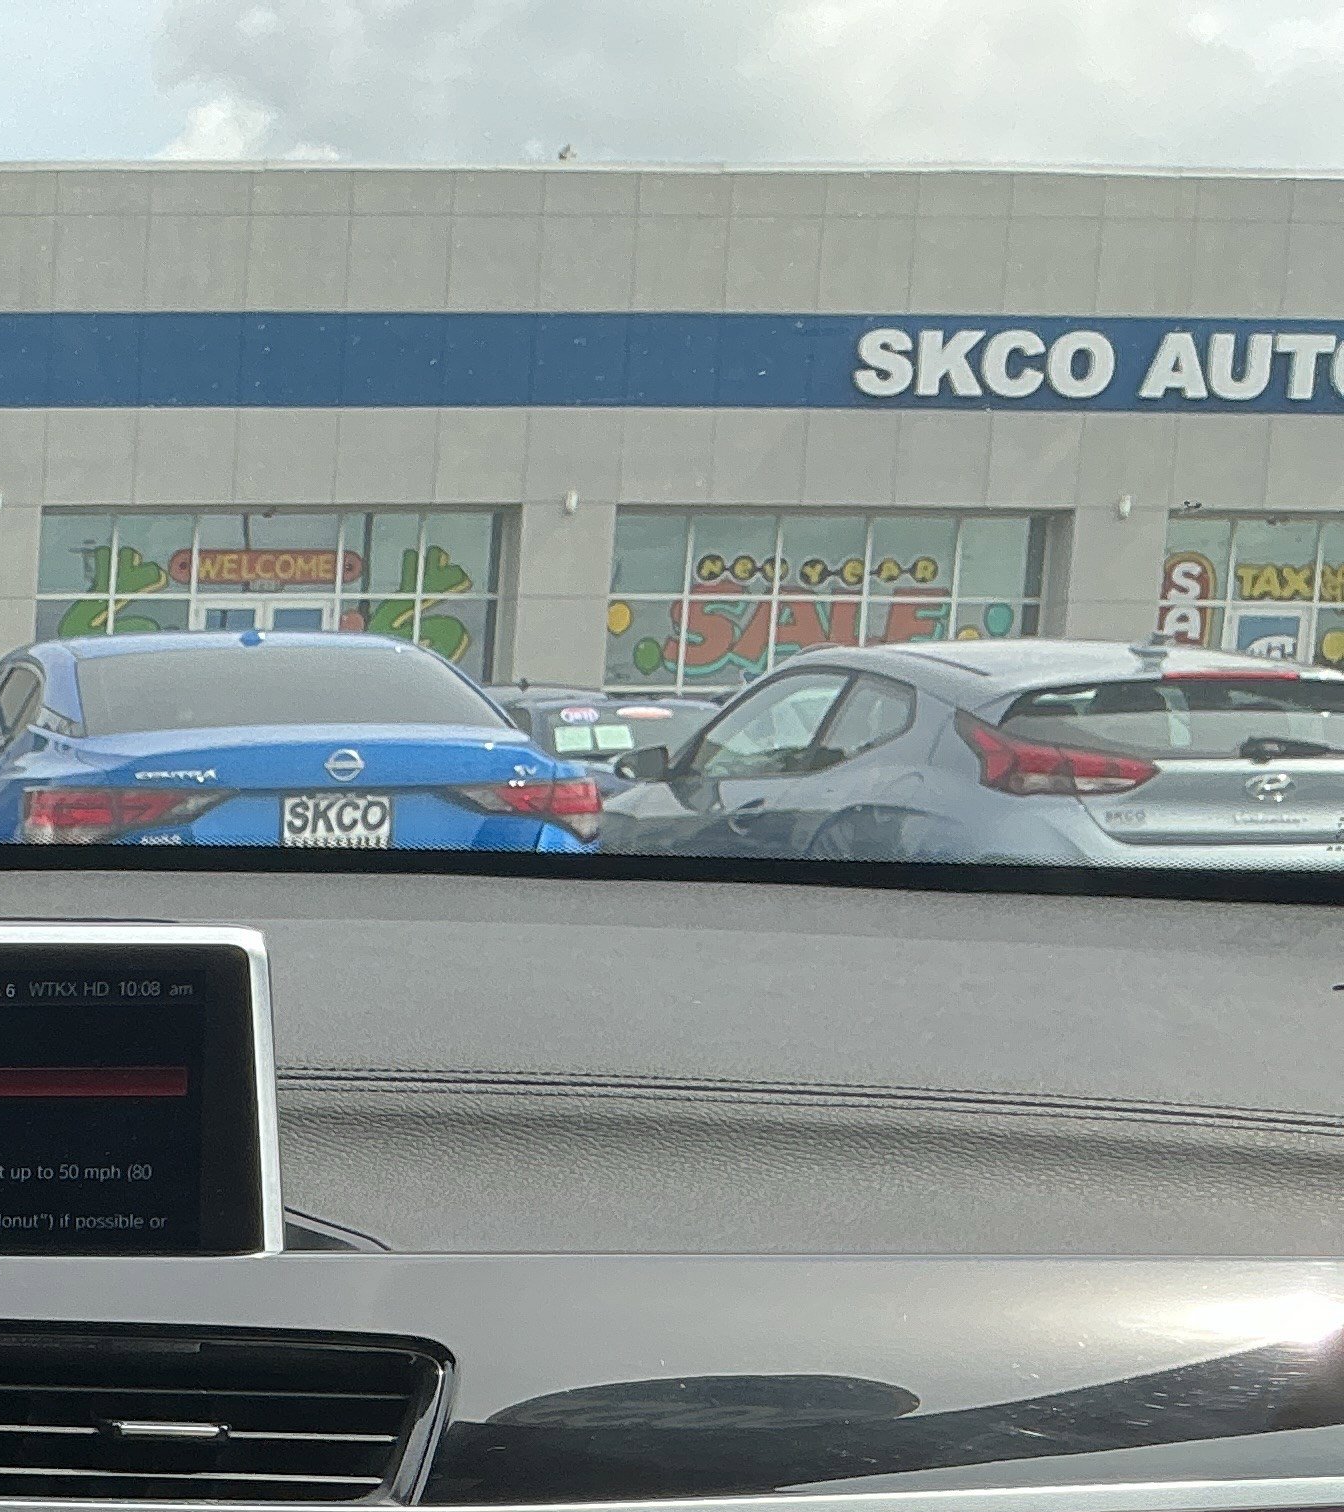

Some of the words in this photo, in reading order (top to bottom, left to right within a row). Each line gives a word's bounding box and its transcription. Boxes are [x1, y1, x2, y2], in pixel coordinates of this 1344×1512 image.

[852, 328, 1115, 399] SKCO
[1138, 331, 1344, 400] AUT
[198, 554, 336, 580] WELCOME
[1236, 564, 1315, 598] TAX
[286, 800, 388, 835] SKCO
[5, 983, 16, 998] 6
[29, 981, 77, 997] WTKX
[84, 981, 109, 997] HD
[119, 980, 161, 997] 10:08
[169, 984, 194, 996] am
[10, 1166, 32, 1183] up
[37, 1165, 54, 1180] to
[59, 1163, 80, 1180] 50
[83, 1164, 121, 1183] mph
[127, 1163, 153, 1182] (80
[59, 1213, 71, 1229] if
[75, 1213, 145, 1230] possible
[148, 1216, 168, 1229] or
